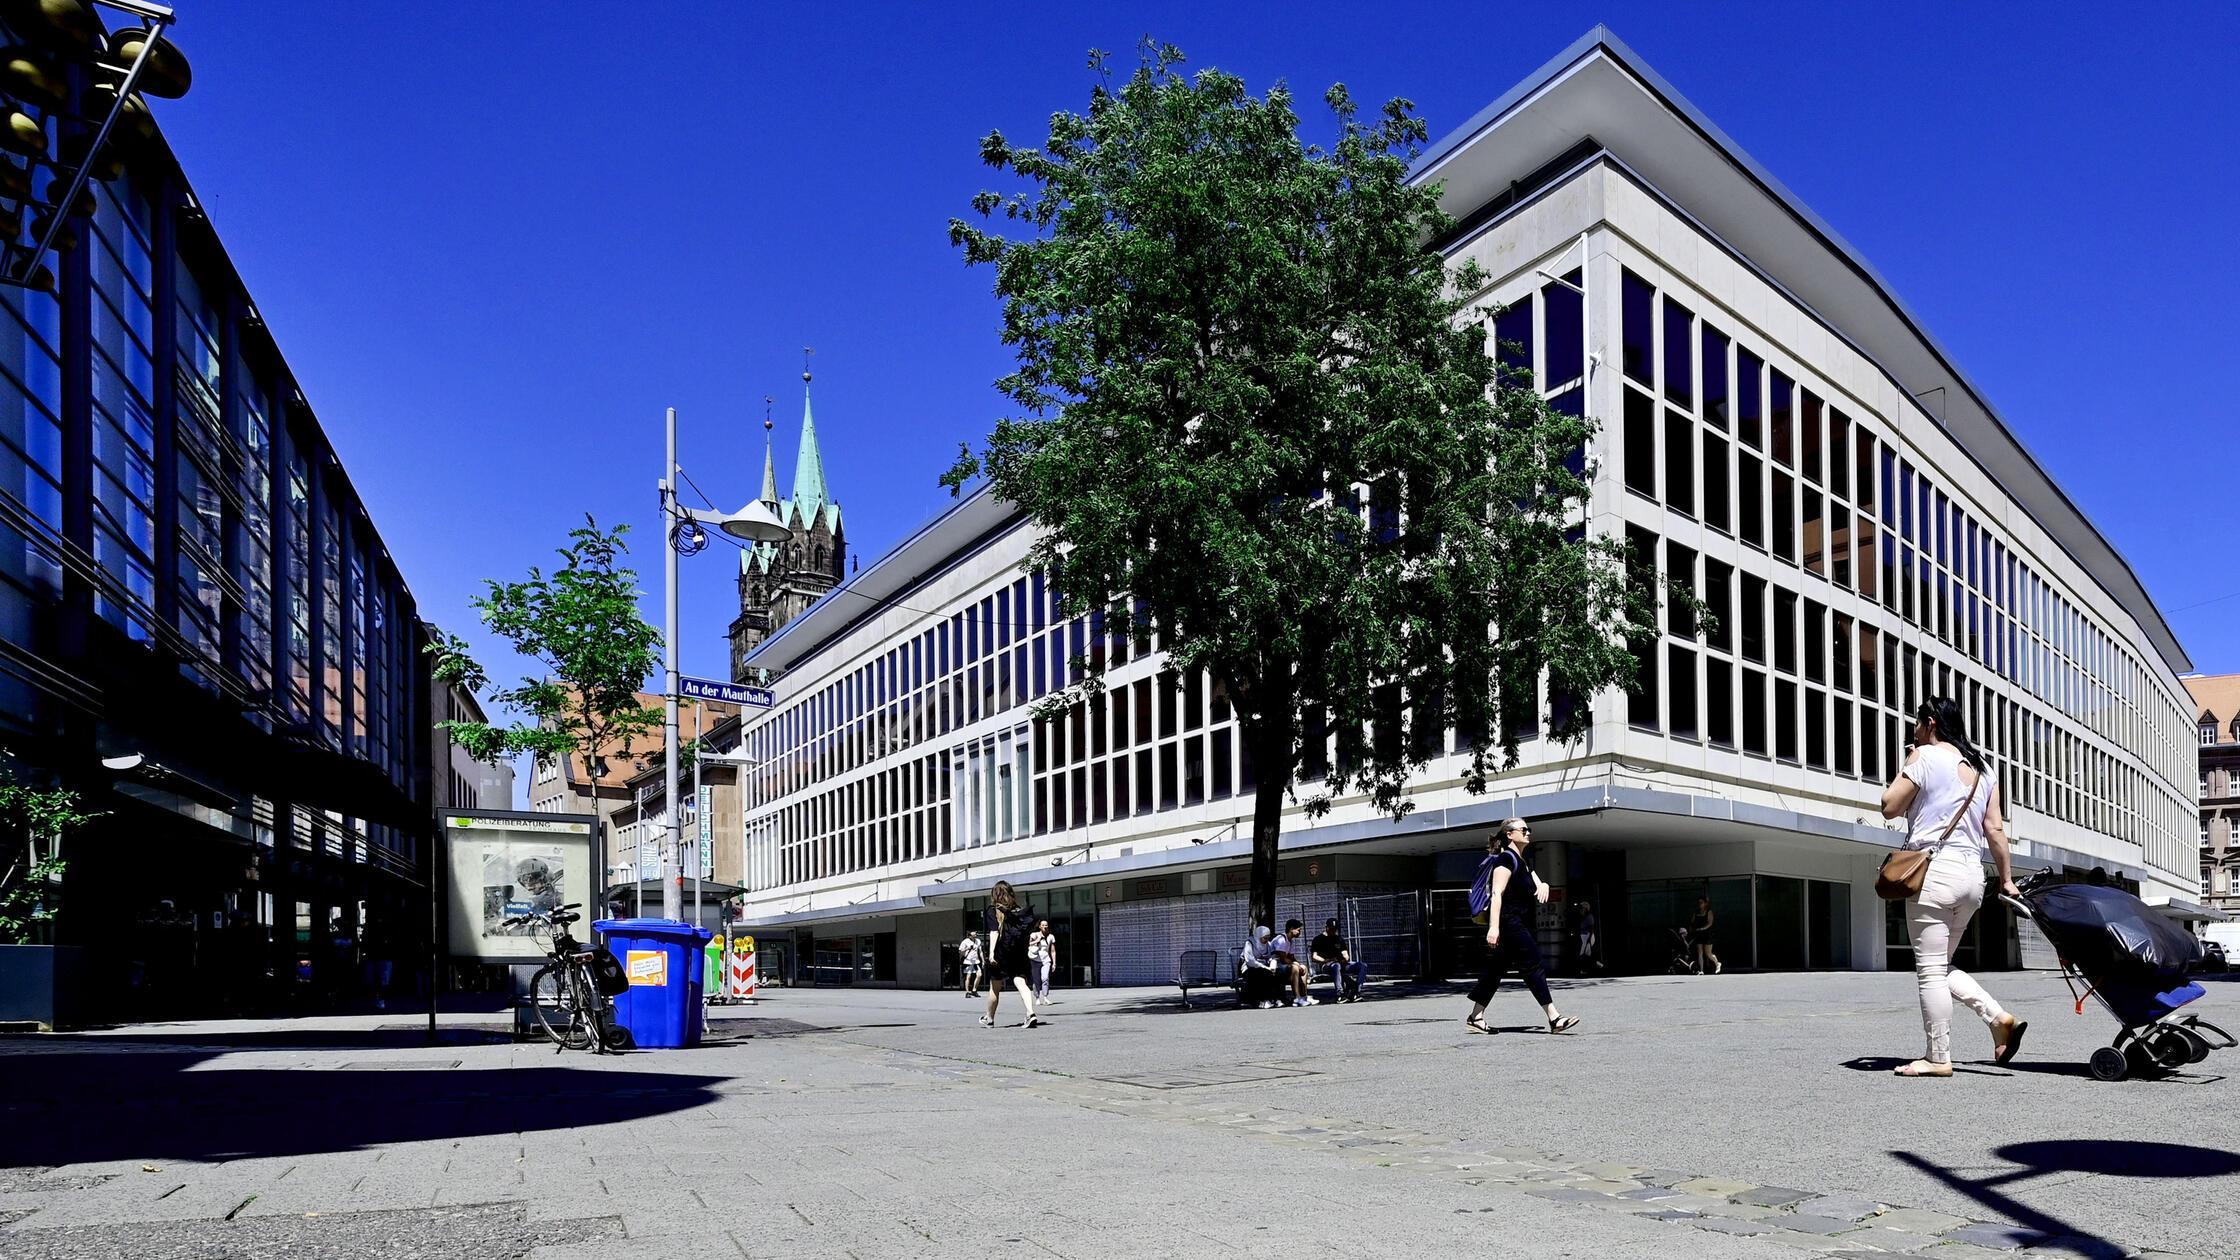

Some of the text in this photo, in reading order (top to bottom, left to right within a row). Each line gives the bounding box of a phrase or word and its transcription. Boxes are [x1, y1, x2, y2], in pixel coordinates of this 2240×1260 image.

[685, 681, 770, 705] An der Mauthalle
